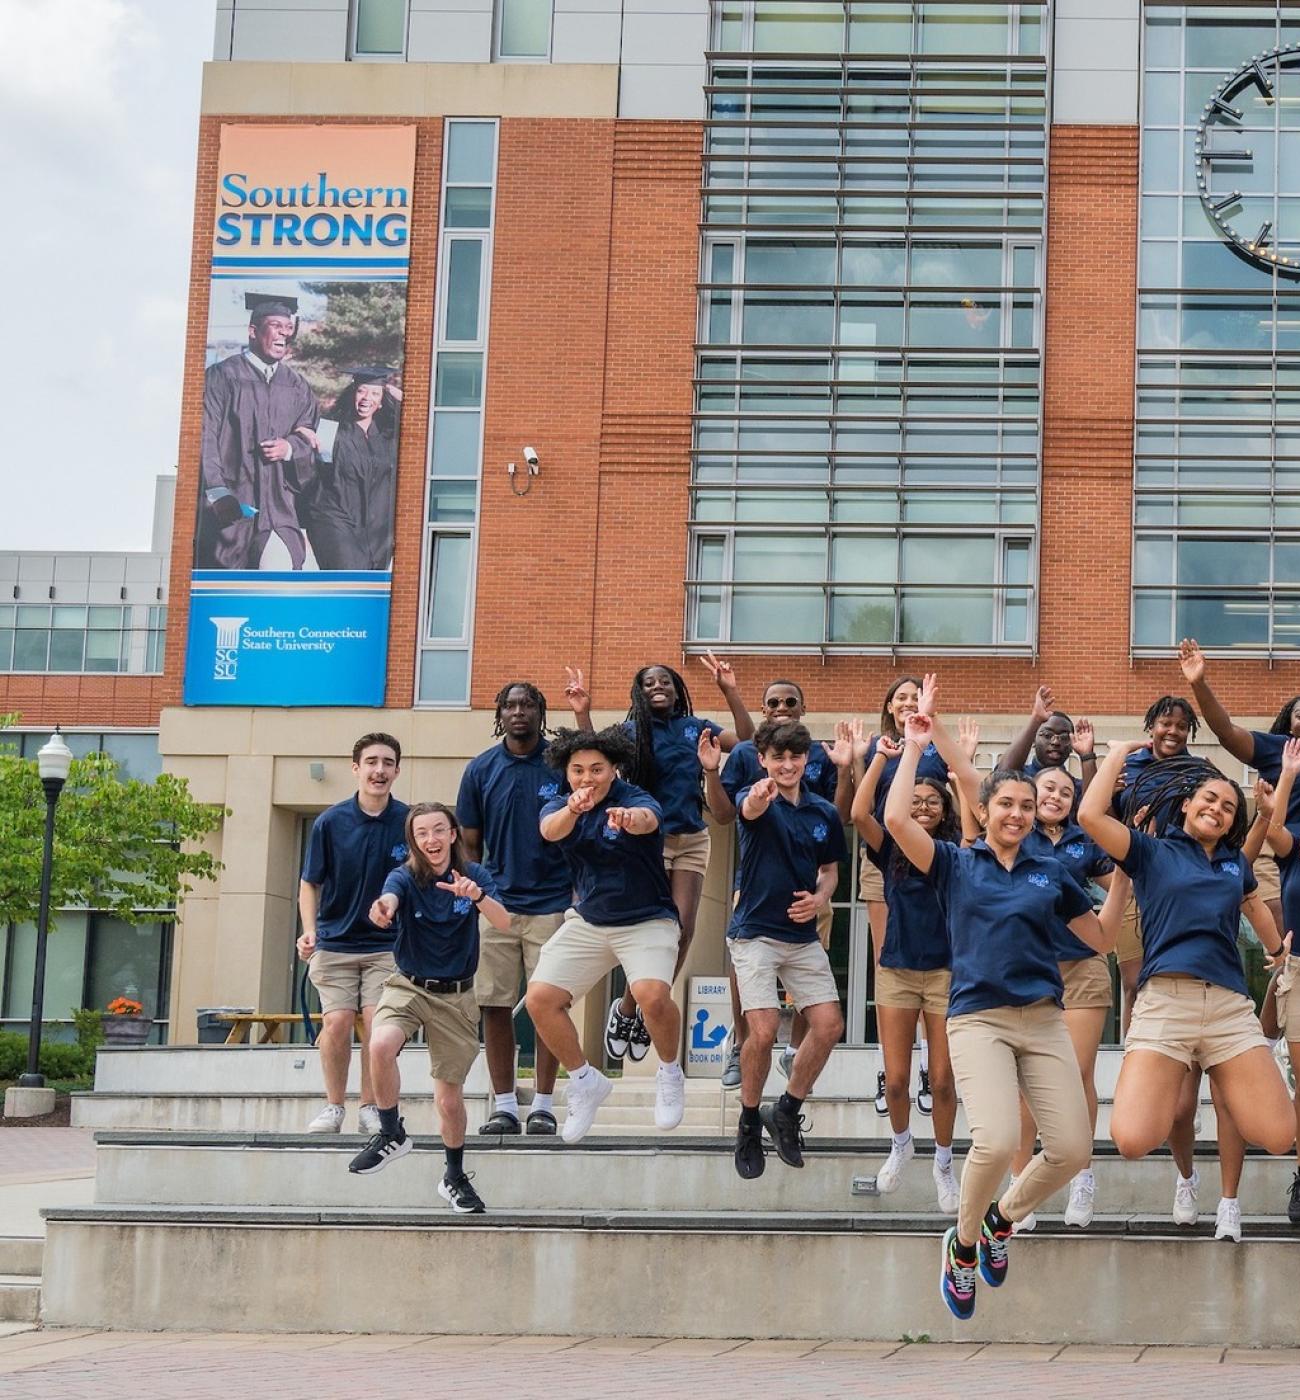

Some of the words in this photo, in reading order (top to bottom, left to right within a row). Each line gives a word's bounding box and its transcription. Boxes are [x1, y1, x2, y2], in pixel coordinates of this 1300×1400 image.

[221, 172, 409, 208] Southern
[216, 212, 407, 247] STRONG
[242, 627, 295, 638] Southern
[298, 627, 367, 639] Connecticut
[242, 639, 272, 650] State
[276, 639, 335, 653] University
[215, 649, 238, 662] SC
[214, 663, 237, 677] SU
[697, 985, 726, 995] LIBRARY
[688, 1054, 708, 1063] BOOK
